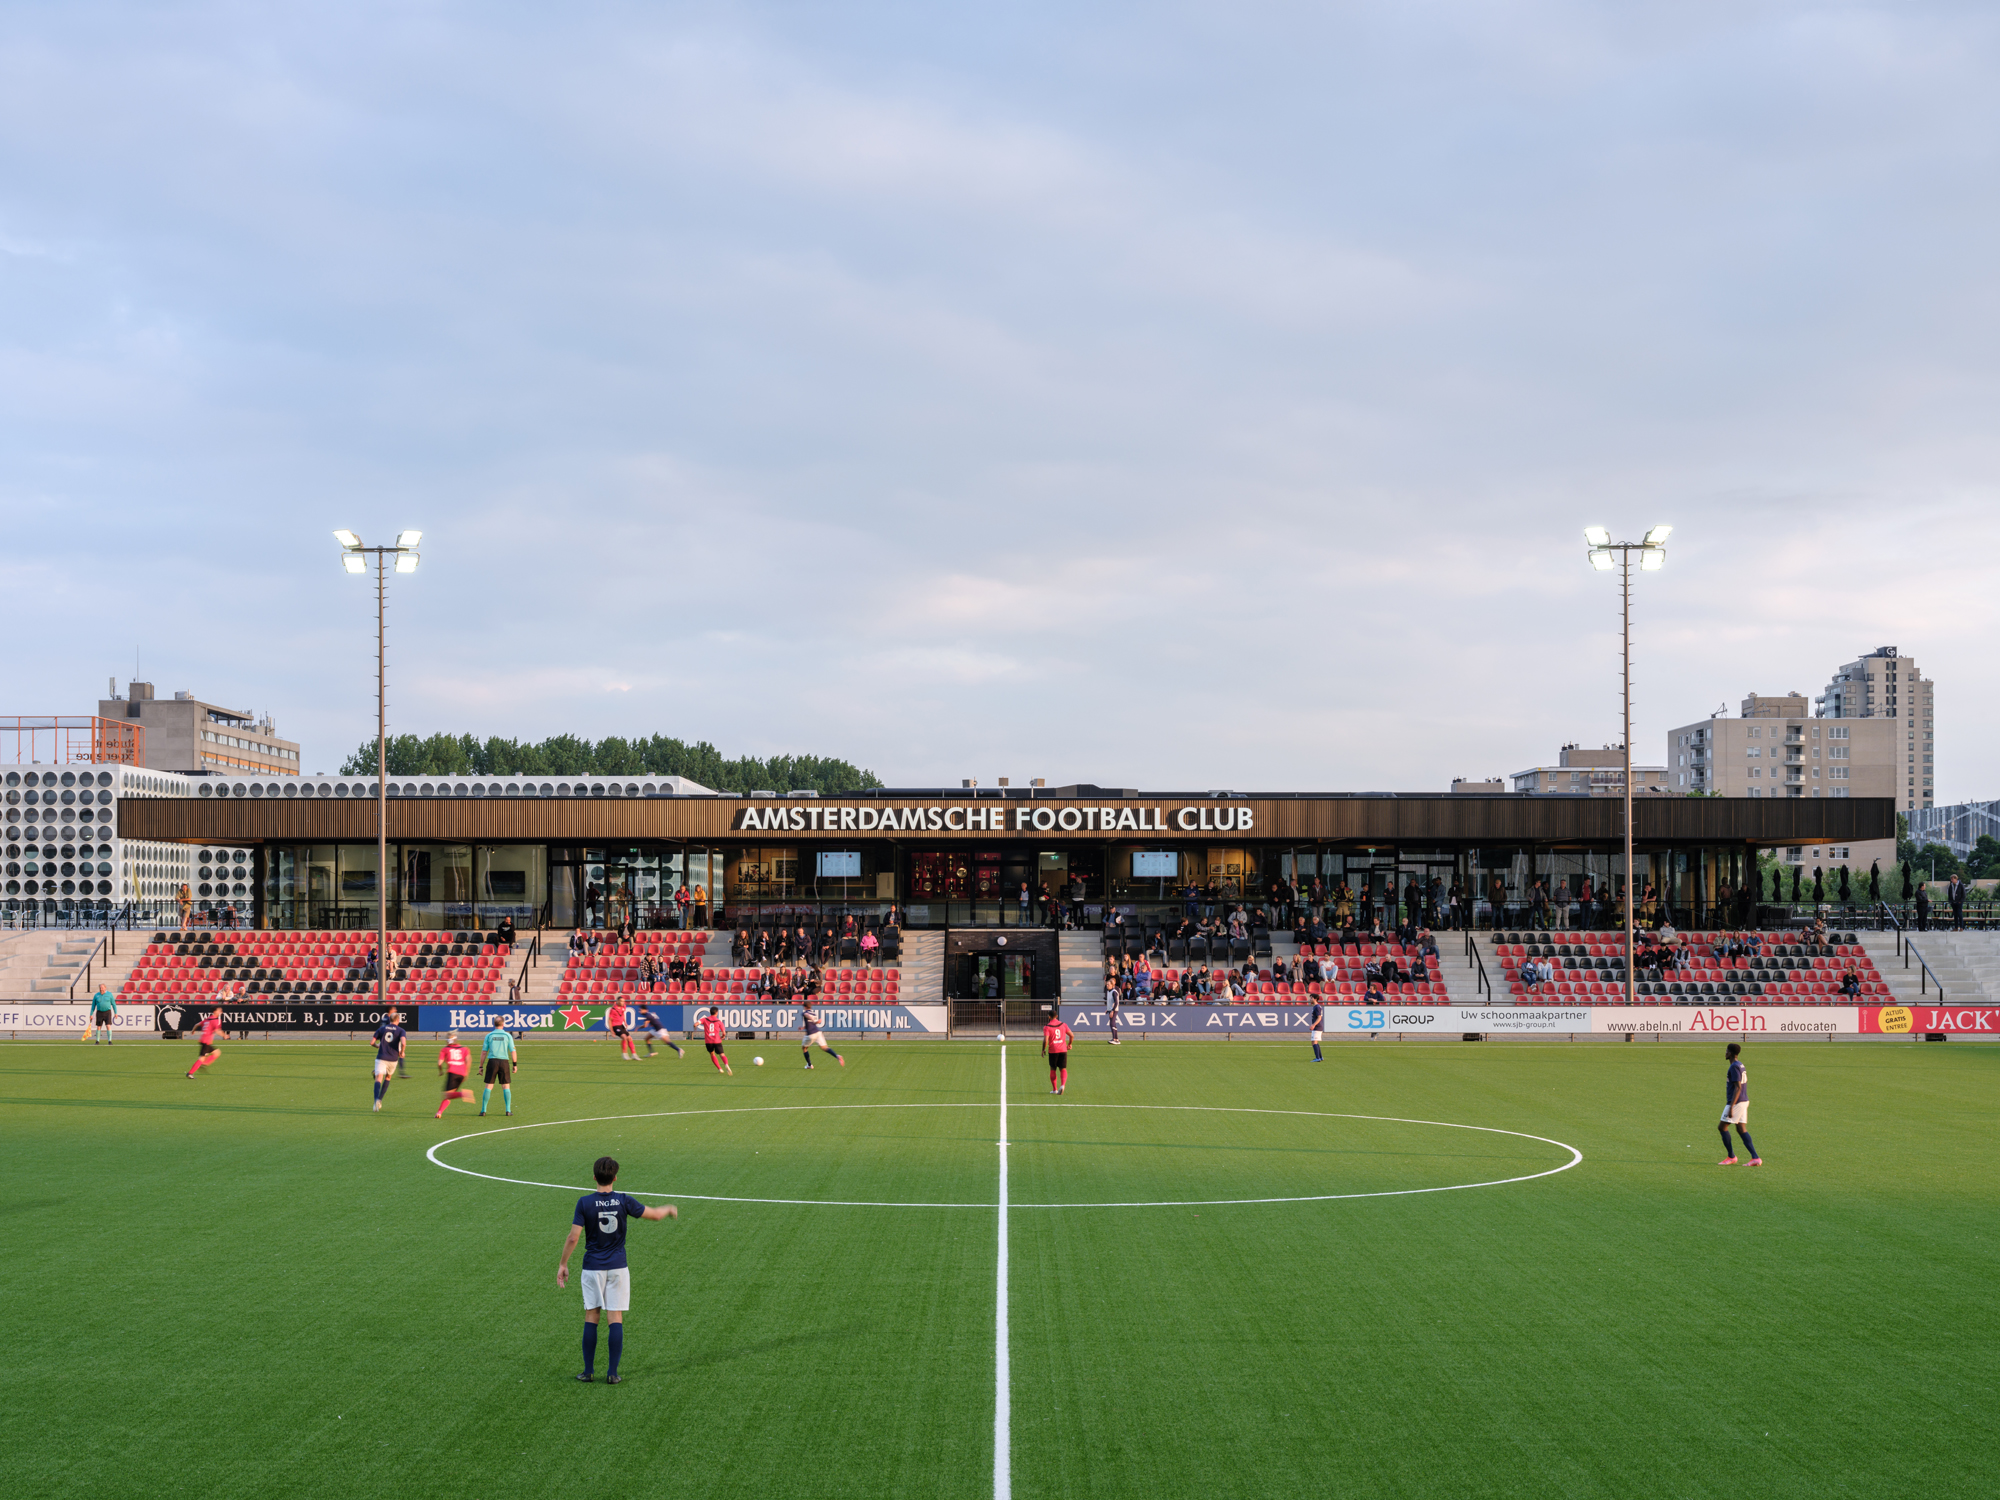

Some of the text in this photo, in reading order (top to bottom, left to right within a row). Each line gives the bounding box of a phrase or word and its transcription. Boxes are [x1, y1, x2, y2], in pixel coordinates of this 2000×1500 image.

[740, 806, 1254, 830] AMSTERDAMSCHE FOOTBALL CLUB
[25, 1014, 152, 1026] LOYENS OEFF
[303, 1012, 328, 1026] B.J.
[334, 1012, 354, 1023] DE
[449, 1009, 554, 1028] Heineken
[719, 1009, 773, 1028] HOUSE
[776, 1009, 798, 1028] OF
[1205, 1012, 1310, 1027] ATABIX
[1347, 1010, 1385, 1029] SJB
[1392, 1015, 1435, 1025] GROUP
[1461, 1011, 1587, 1021] Uw schoonmaakpartner
[1607, 1009, 1837, 1031] www.abeln.nl Abeln advocaten
[1493, 1021, 1556, 1029] www.sjb-group.nl
[1054, 1028, 1061, 1040] 9
[598, 1211, 618, 1234] 5
